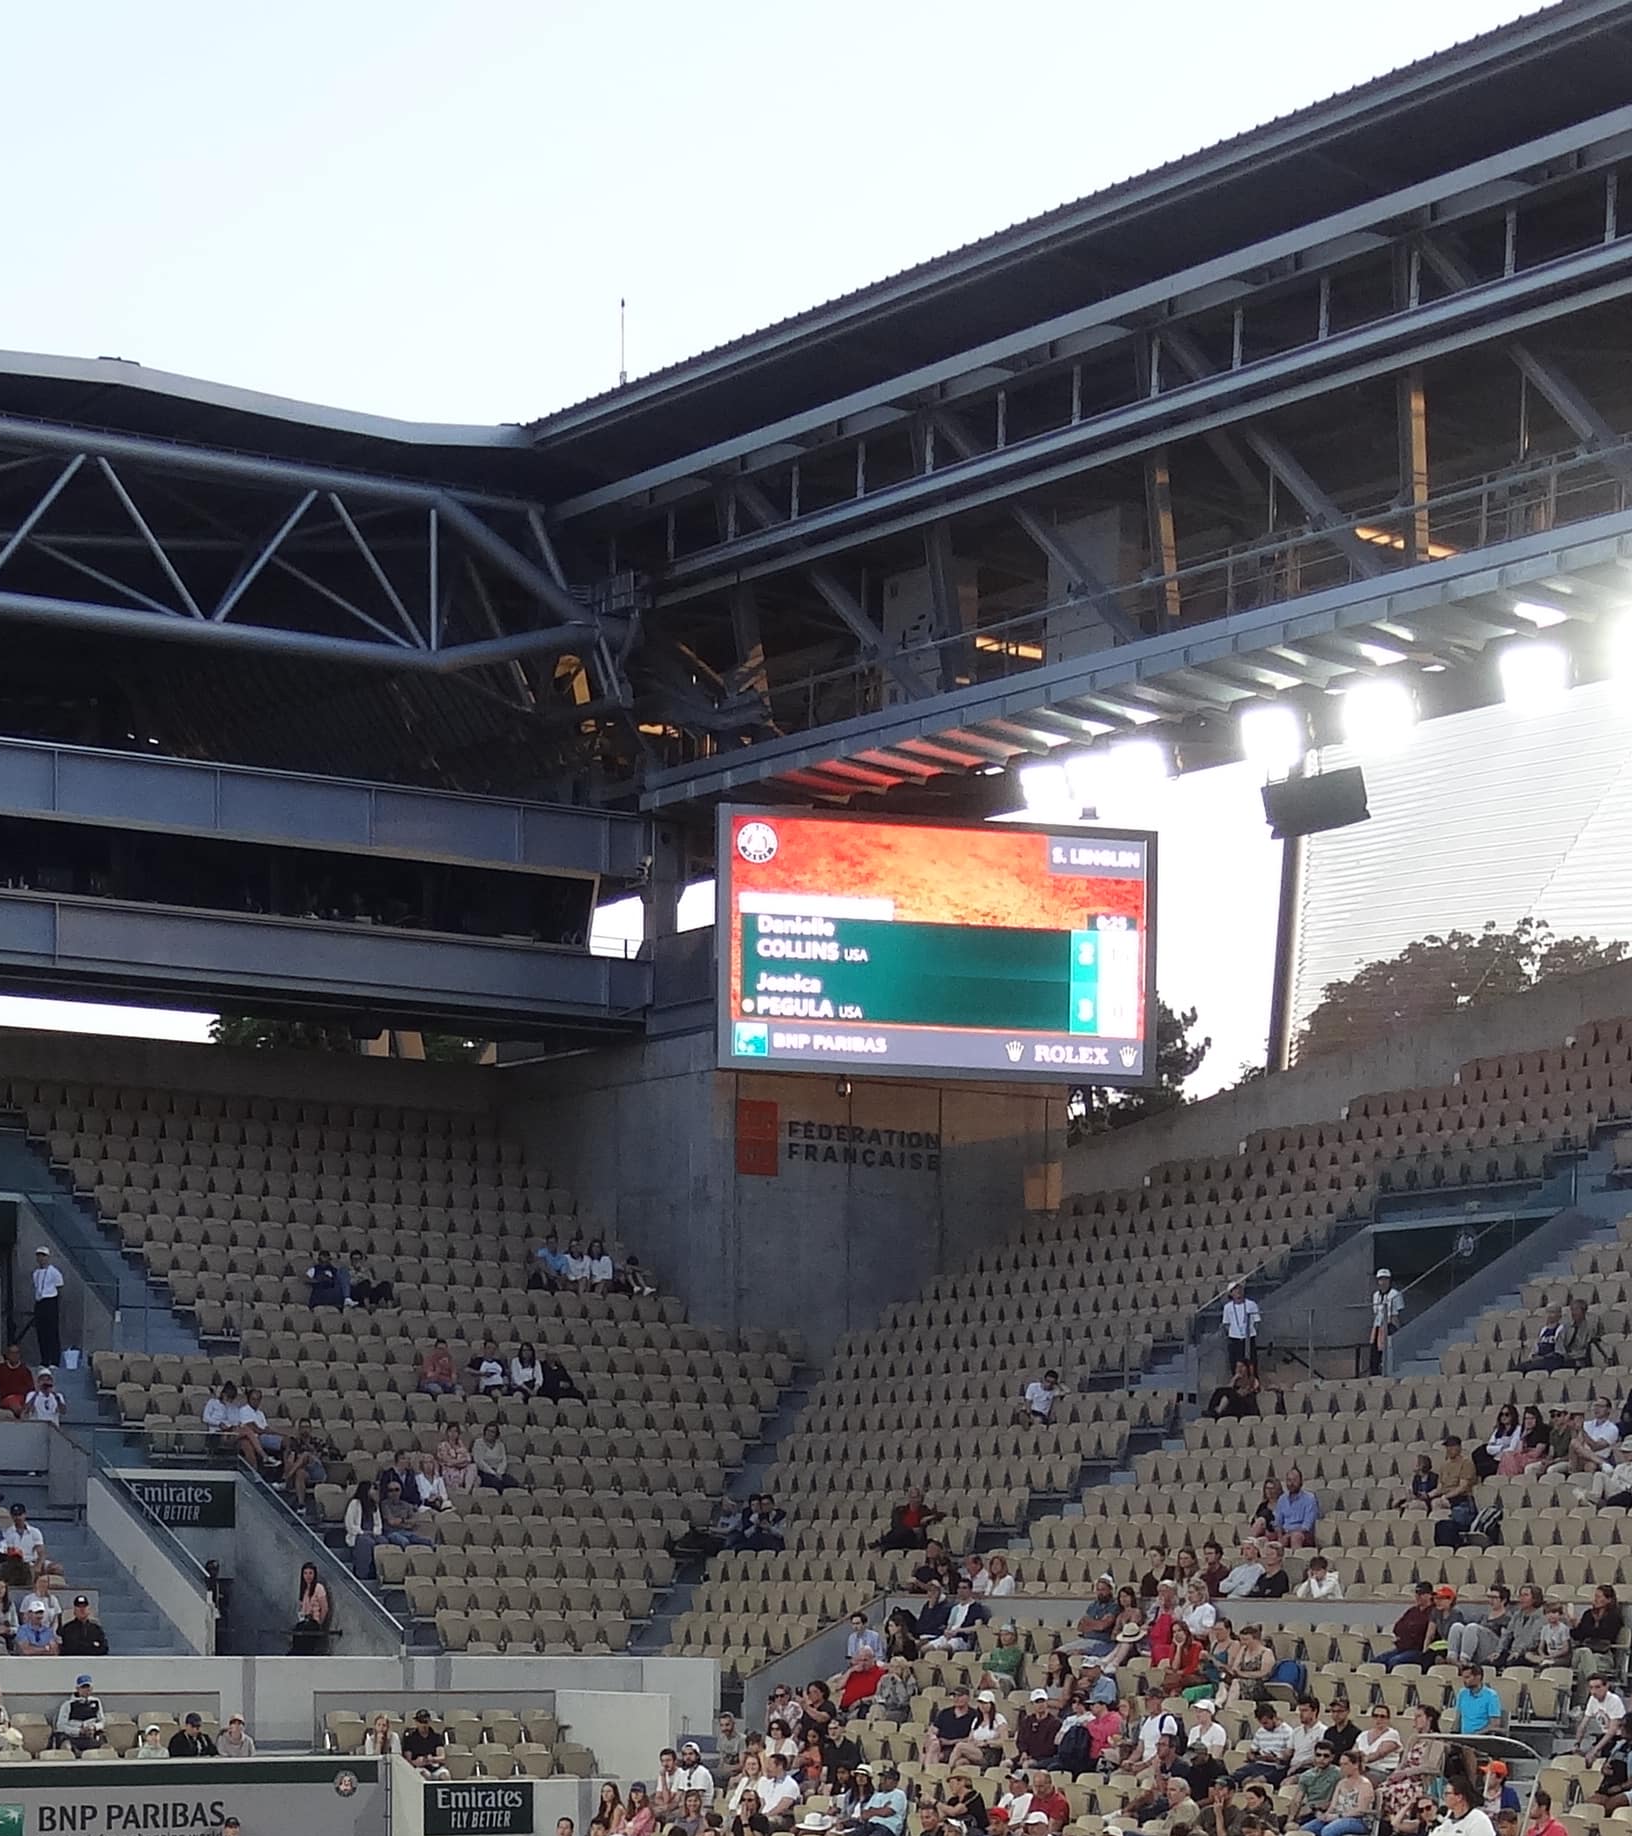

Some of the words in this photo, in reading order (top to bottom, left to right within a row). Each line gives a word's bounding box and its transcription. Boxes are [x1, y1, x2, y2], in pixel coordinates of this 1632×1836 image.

[758, 915, 835, 936] Danielle
[757, 939, 839, 961] COLLINS
[844, 948, 868, 962] USA
[756, 972, 821, 993] Jessica
[757, 996, 834, 1018] PEGULA
[839, 1005, 863, 1019] USA
[773, 1032, 810, 1048] BNP
[814, 1035, 887, 1053] PARIBAS
[1034, 1045, 1109, 1065] ROLEX
[788, 1142, 941, 1171] FRANÇAISE
[132, 1482, 213, 1503] Emirates
[164, 1505, 200, 1521] BETTER
[437, 1787, 522, 1809] Emirates
[38, 1805, 97, 1831] BNP
[106, 1801, 225, 1831] PARIBAS
[451, 1811, 468, 1828] FLY
[471, 1810, 511, 1828] BETTER
